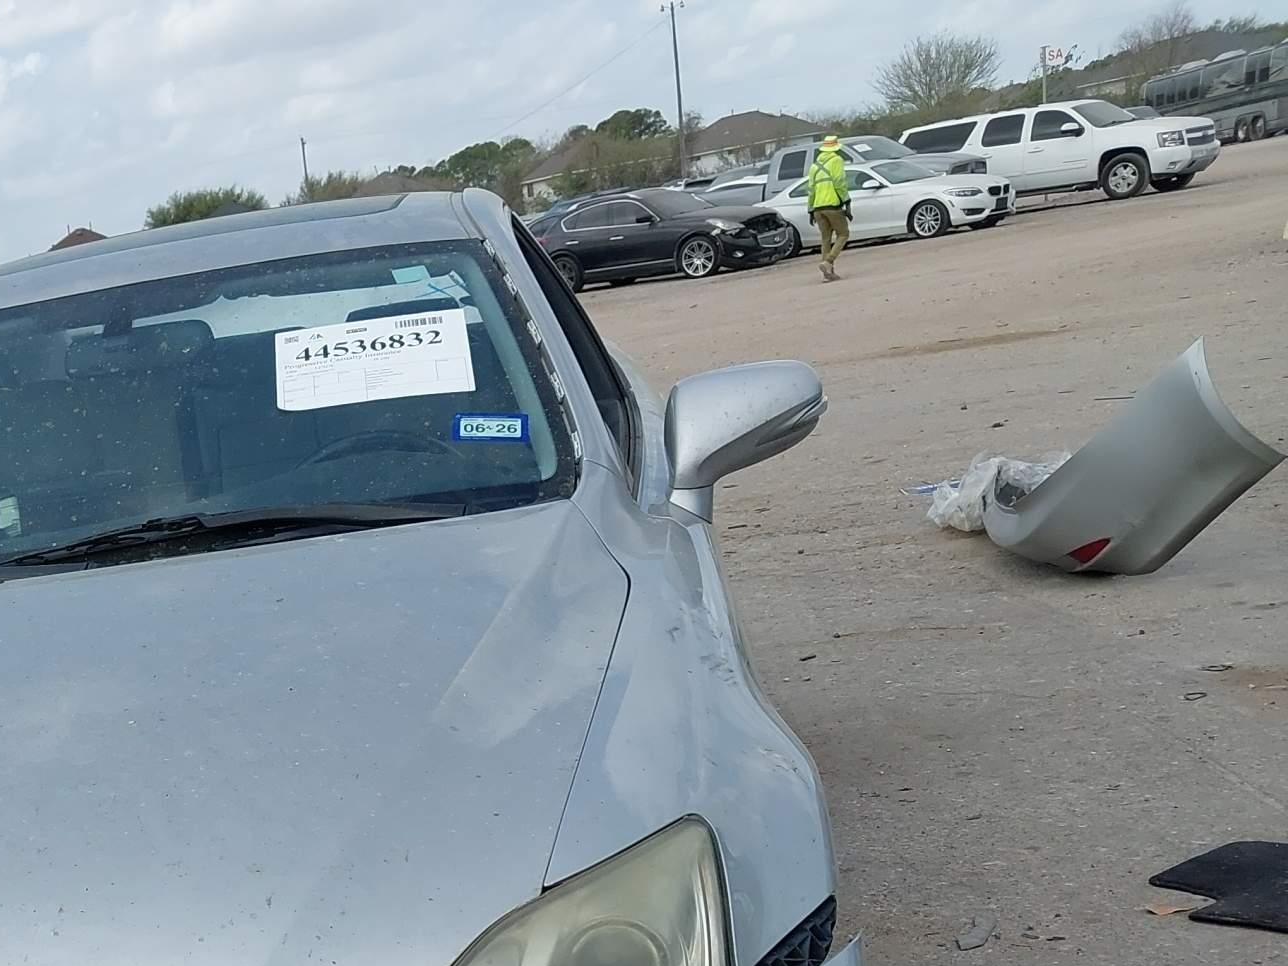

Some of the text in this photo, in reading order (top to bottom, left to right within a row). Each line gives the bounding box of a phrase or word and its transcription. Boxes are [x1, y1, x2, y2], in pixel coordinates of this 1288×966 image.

[295, 330, 443, 361] 44536832
[463, 423, 518, 433] 06 26
